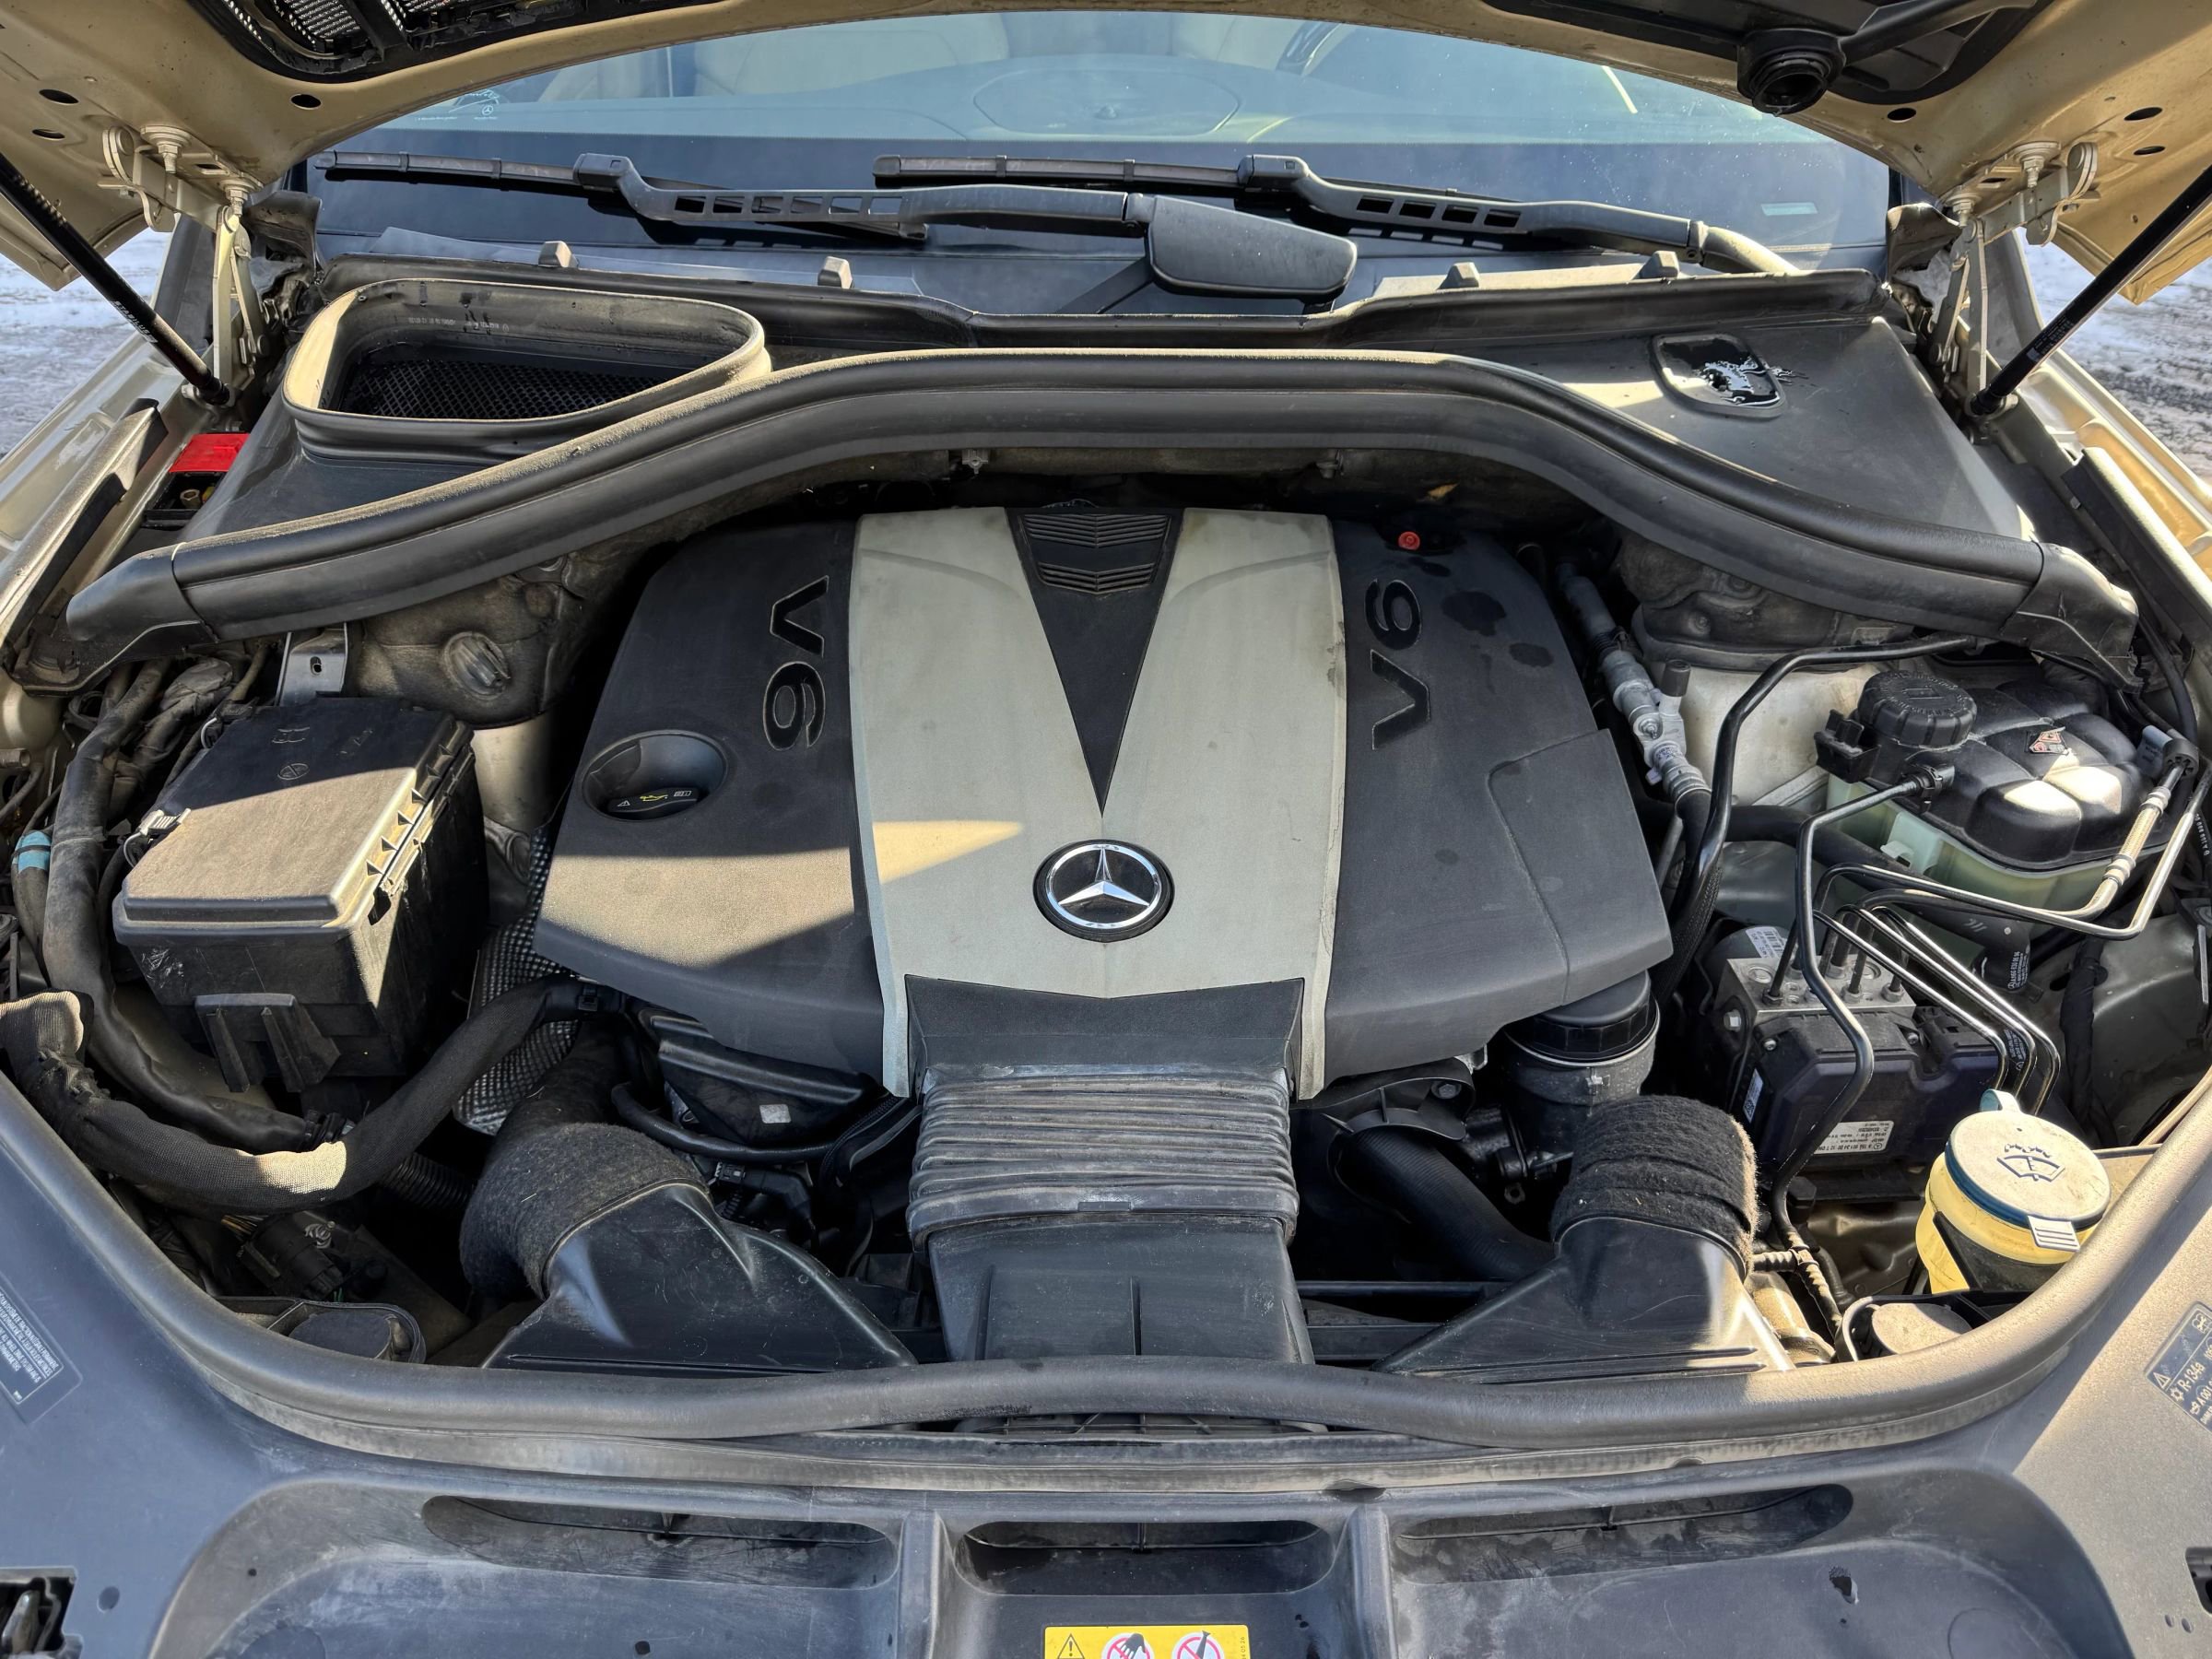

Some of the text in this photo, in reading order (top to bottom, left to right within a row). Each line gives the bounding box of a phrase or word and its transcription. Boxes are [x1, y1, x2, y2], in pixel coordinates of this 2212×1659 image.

[763, 575, 829, 751] V6
[1365, 579, 1430, 750] V6
[2177, 1362, 2206, 1393] R-134a
